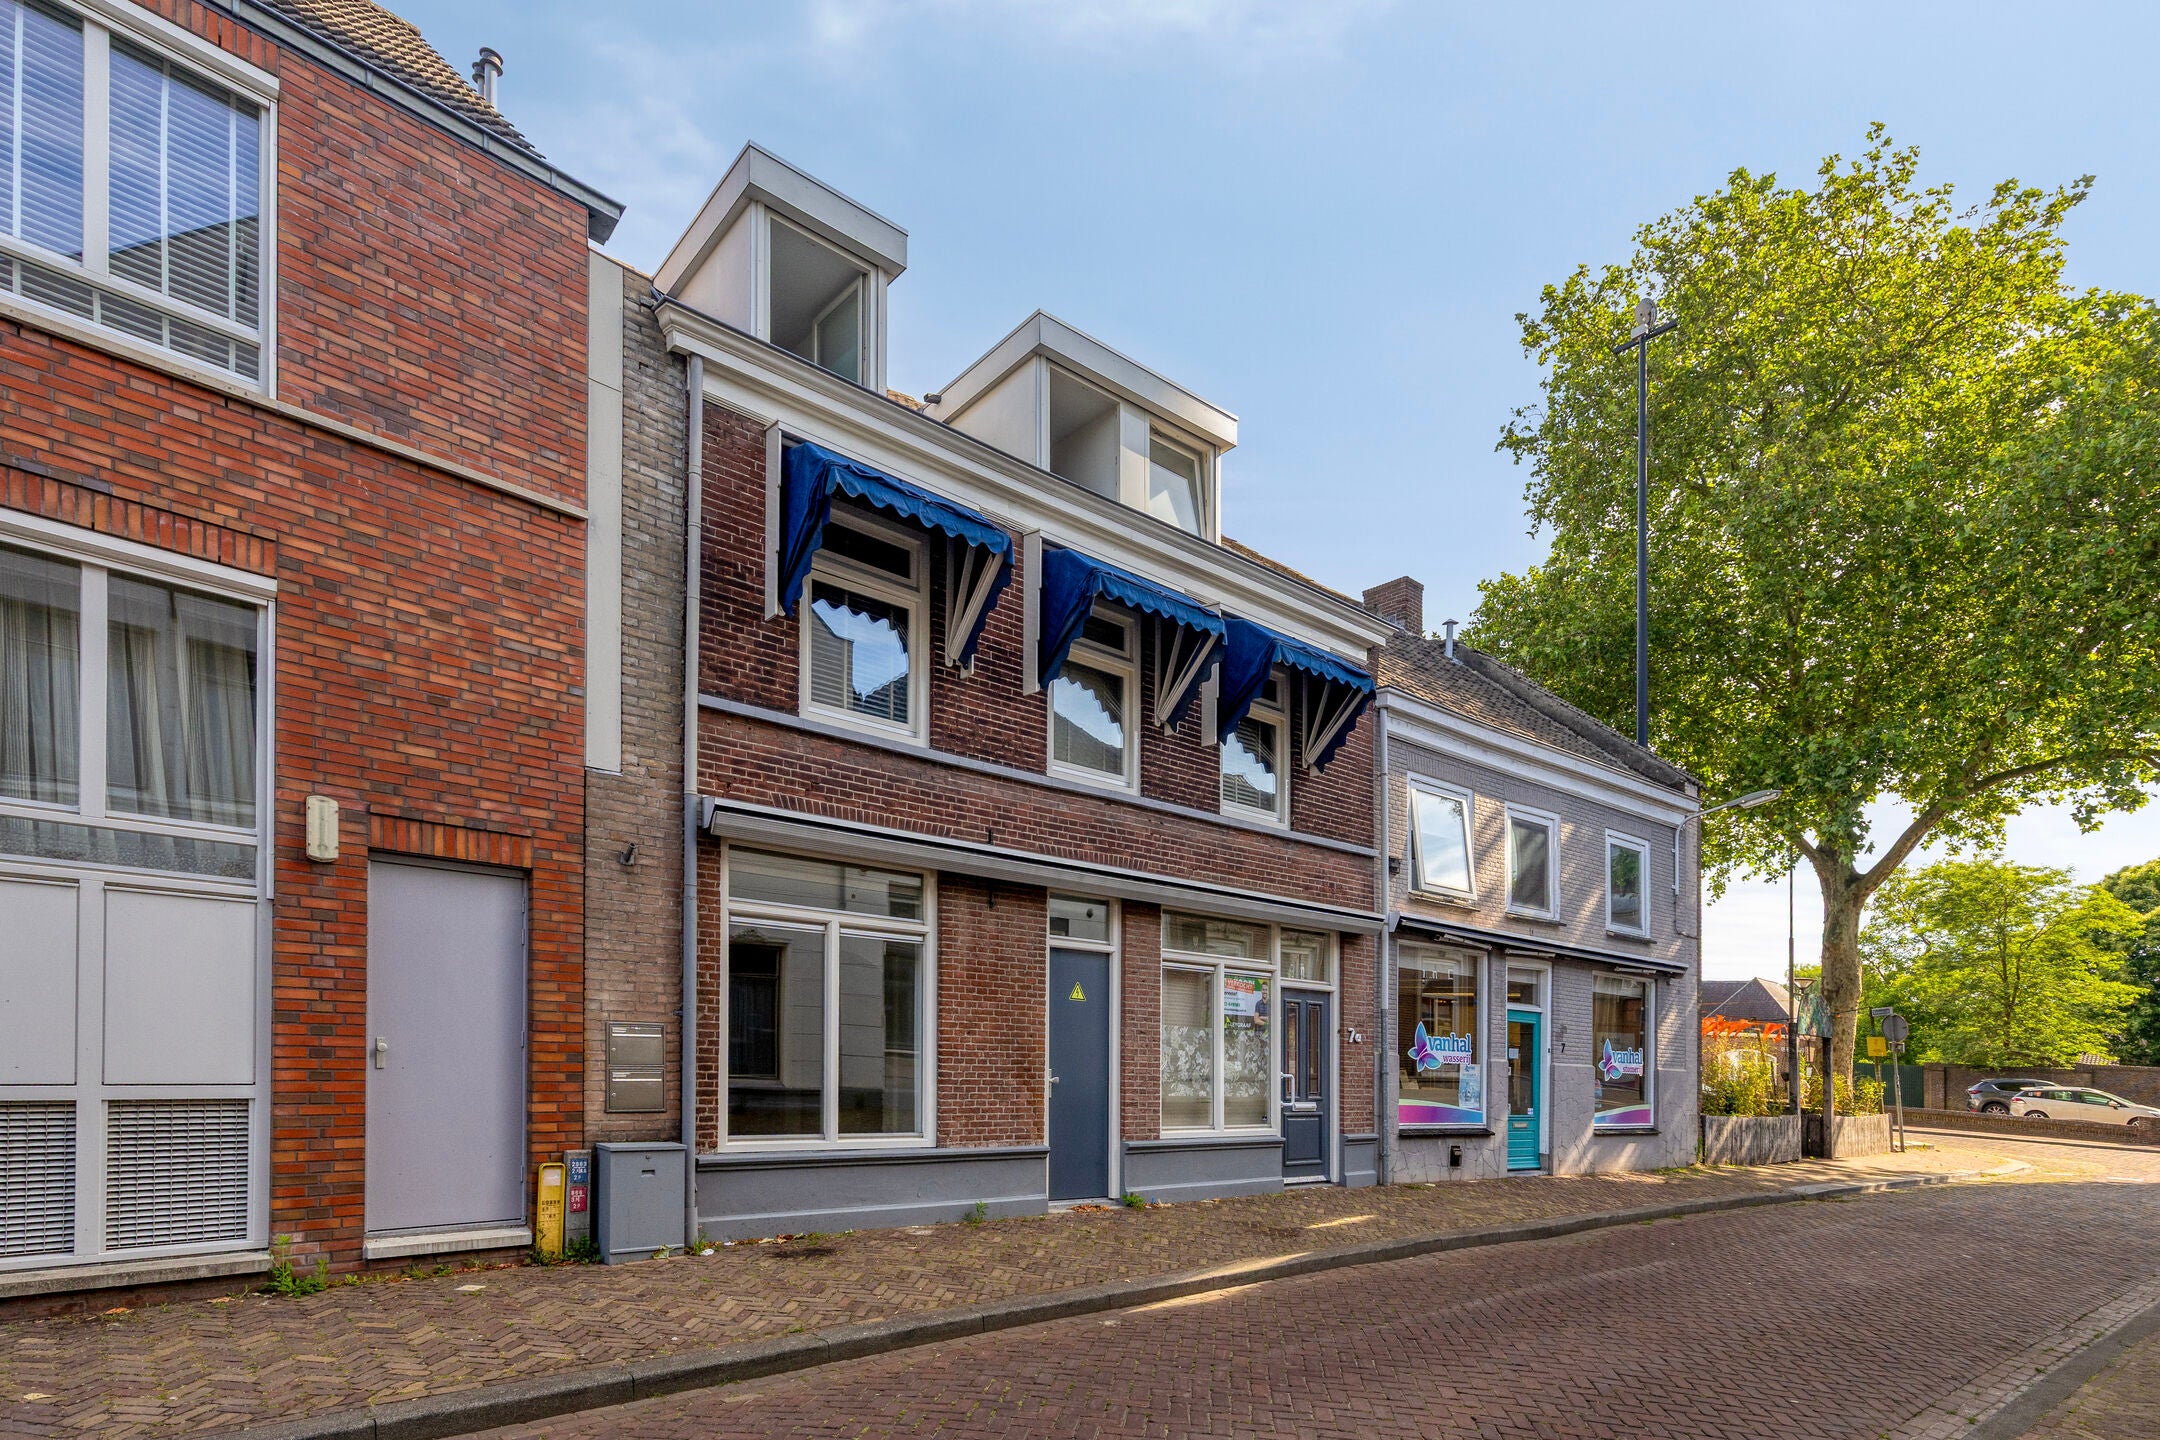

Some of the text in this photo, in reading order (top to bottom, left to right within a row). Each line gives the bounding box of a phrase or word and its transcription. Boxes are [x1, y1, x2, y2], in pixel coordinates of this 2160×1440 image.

[1347, 1027, 1363, 1043] 7a
[1427, 1033, 1472, 1053] vanhal
[1561, 1042, 1566, 1053] 7
[1442, 1054, 1471, 1065] wasserij
[1612, 1048, 1643, 1065] vanhal
